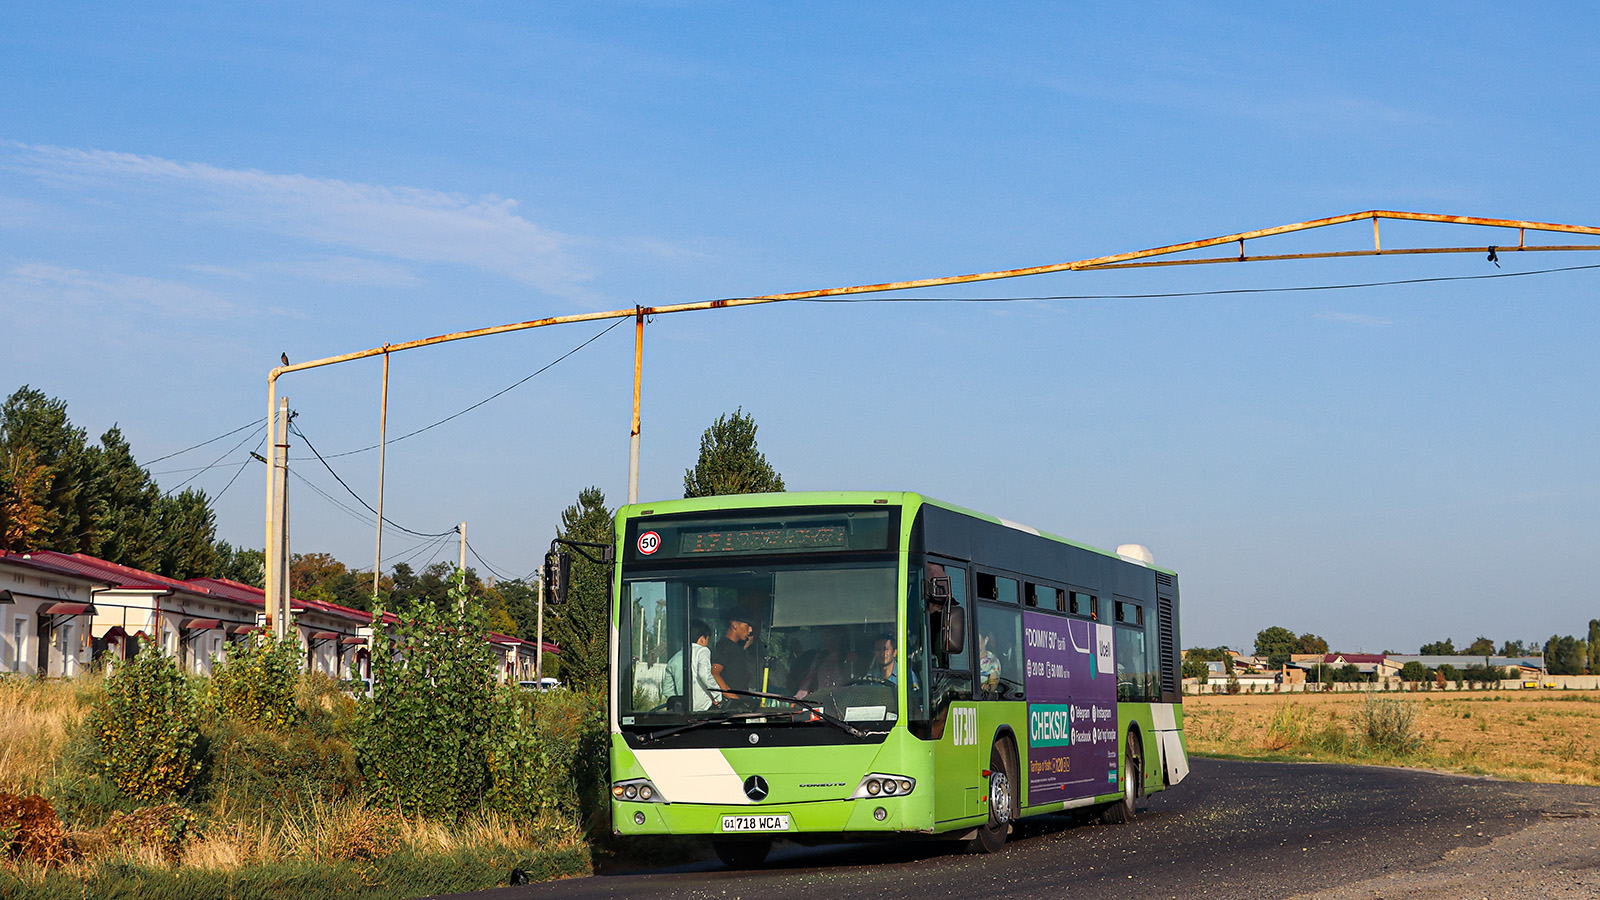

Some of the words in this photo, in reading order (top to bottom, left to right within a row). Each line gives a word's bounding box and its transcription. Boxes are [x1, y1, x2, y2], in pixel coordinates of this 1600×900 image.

[642, 537, 656, 549] 50
[1099, 640, 1111, 658] Ucell
[1075, 706, 1090, 721] Telegram
[1096, 706, 1111, 721] Instagram
[953, 707, 977, 746] 07301
[1031, 711, 1068, 741] CHEKSIZ
[1076, 730, 1091, 743] Facebook
[724, 819, 734, 829] 01
[737, 817, 756, 829] 718
[759, 817, 782, 829] WCA
